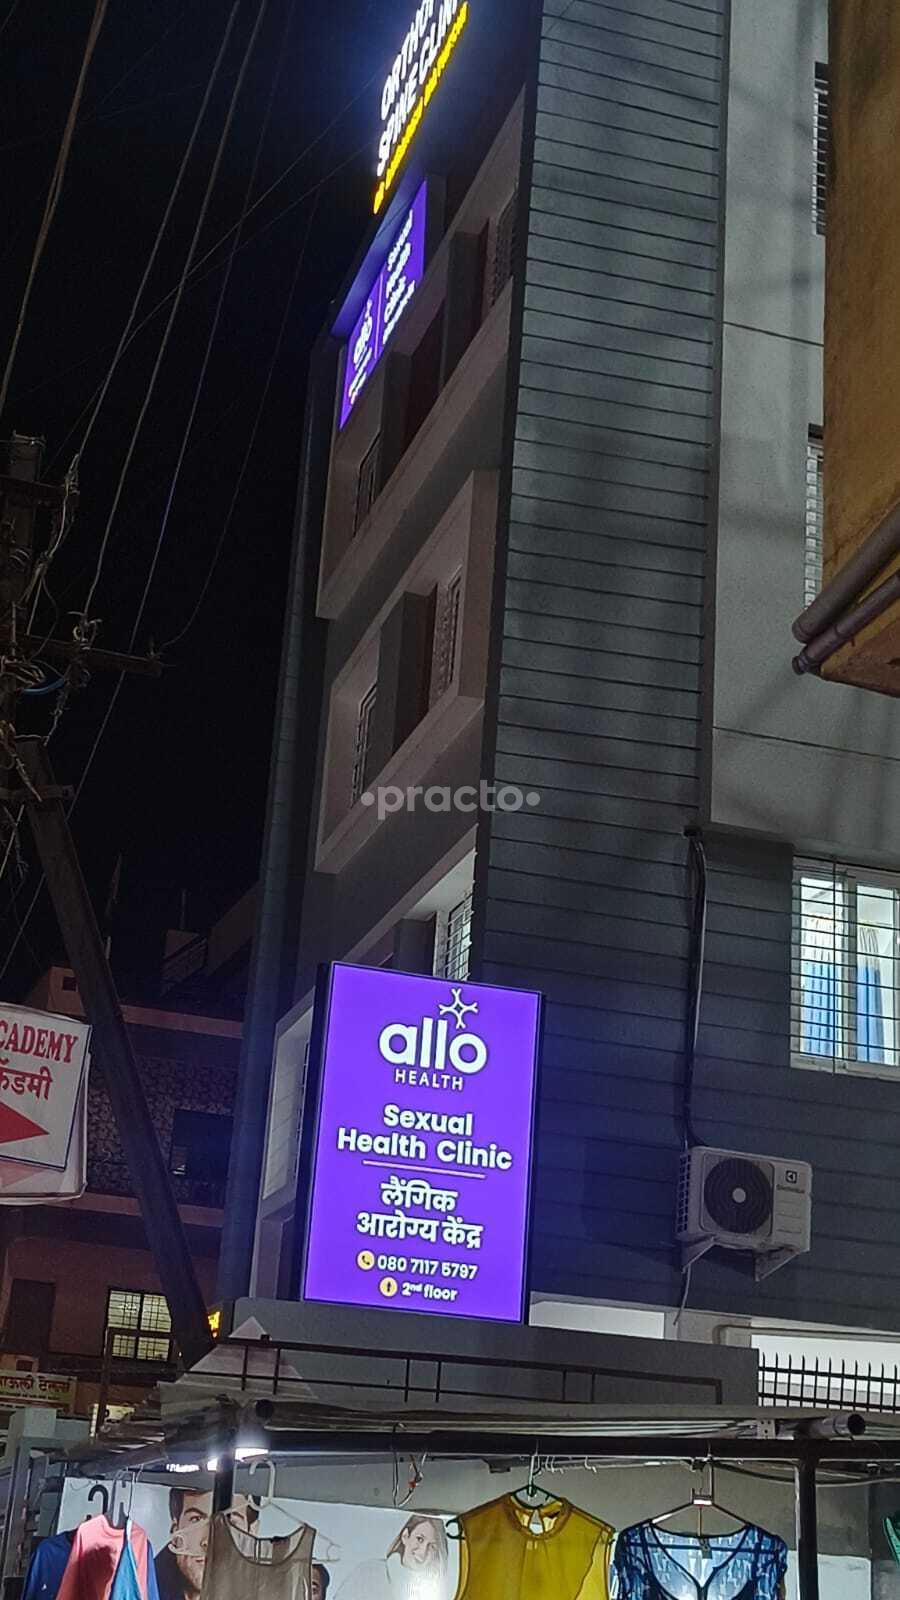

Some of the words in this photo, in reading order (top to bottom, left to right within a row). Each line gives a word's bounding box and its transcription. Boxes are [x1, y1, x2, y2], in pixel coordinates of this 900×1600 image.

[376, 62, 418, 177] SPINE
[379, 1017, 487, 1074] allo
[395, 1068, 464, 1091] HEALTH
[383, 1103, 473, 1136] Sexual
[337, 1127, 426, 1160] Health
[436, 1140, 512, 1170] Clinic
[380, 1175, 459, 1213] लैंगिक
[356, 1210, 440, 1242] आरोग्य
[441, 1216, 484, 1249] केंद्र
[377, 1255, 407, 1272] 080
[410, 1258, 440, 1276] 7117
[441, 1261, 478, 1280] 5797
[401, 1282, 422, 1296] 2nd
[423, 1284, 458, 1301] floor
